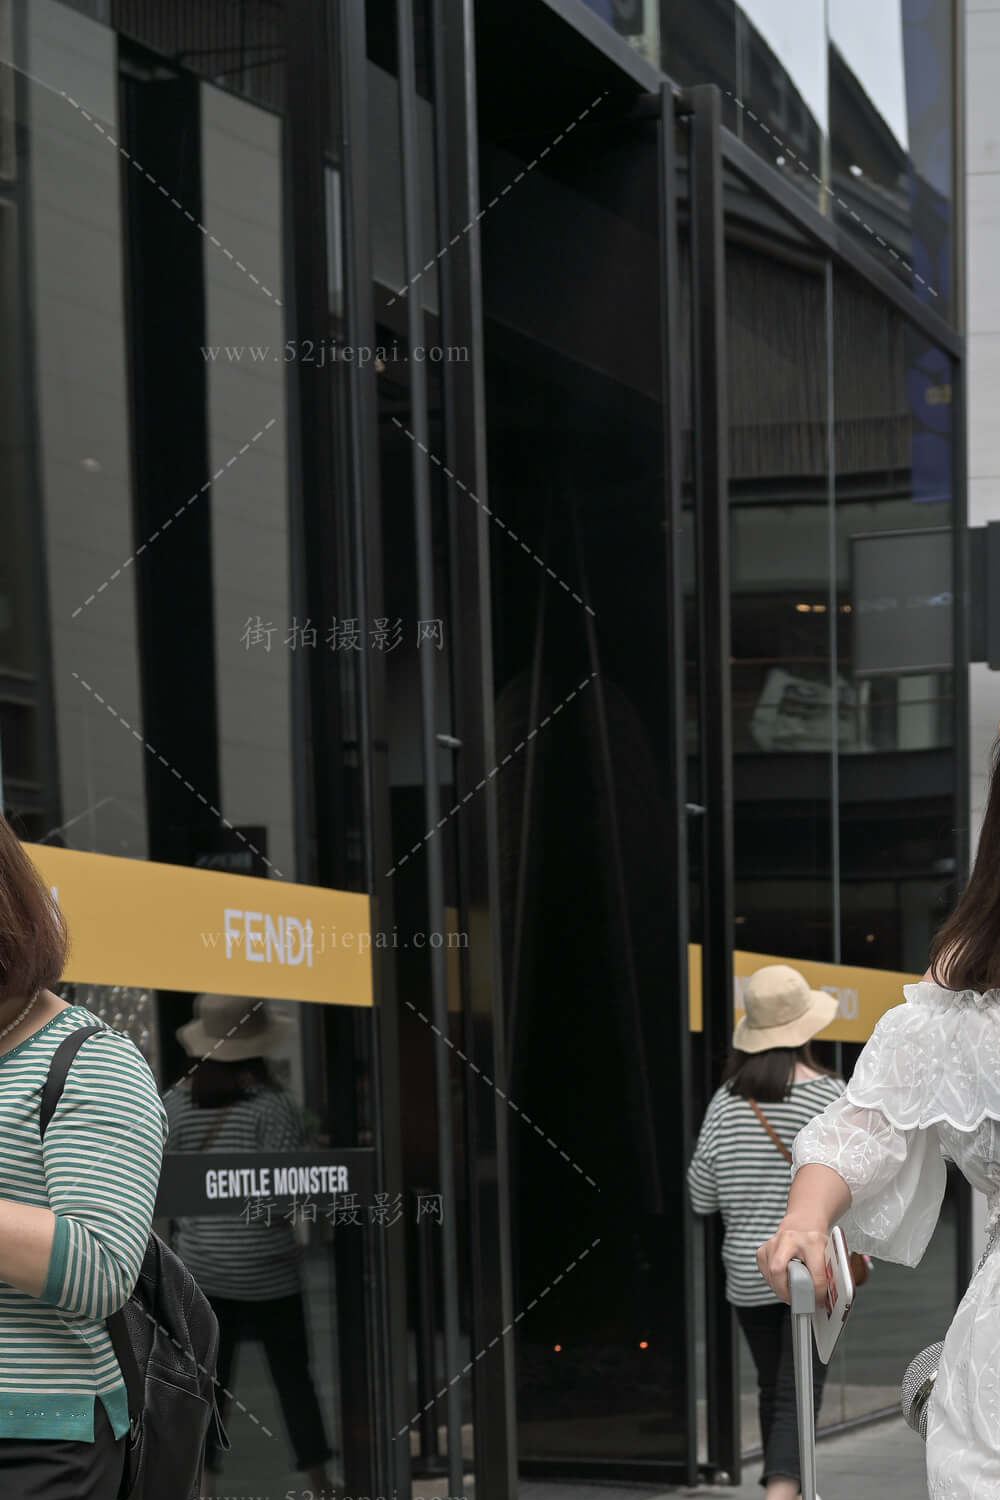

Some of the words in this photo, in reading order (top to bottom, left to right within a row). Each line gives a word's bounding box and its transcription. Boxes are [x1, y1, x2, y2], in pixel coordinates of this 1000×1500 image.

[223, 907, 314, 968] FENDI
[205, 1168, 270, 1200] GENTLE
[274, 1165, 349, 1196] MONSTER
